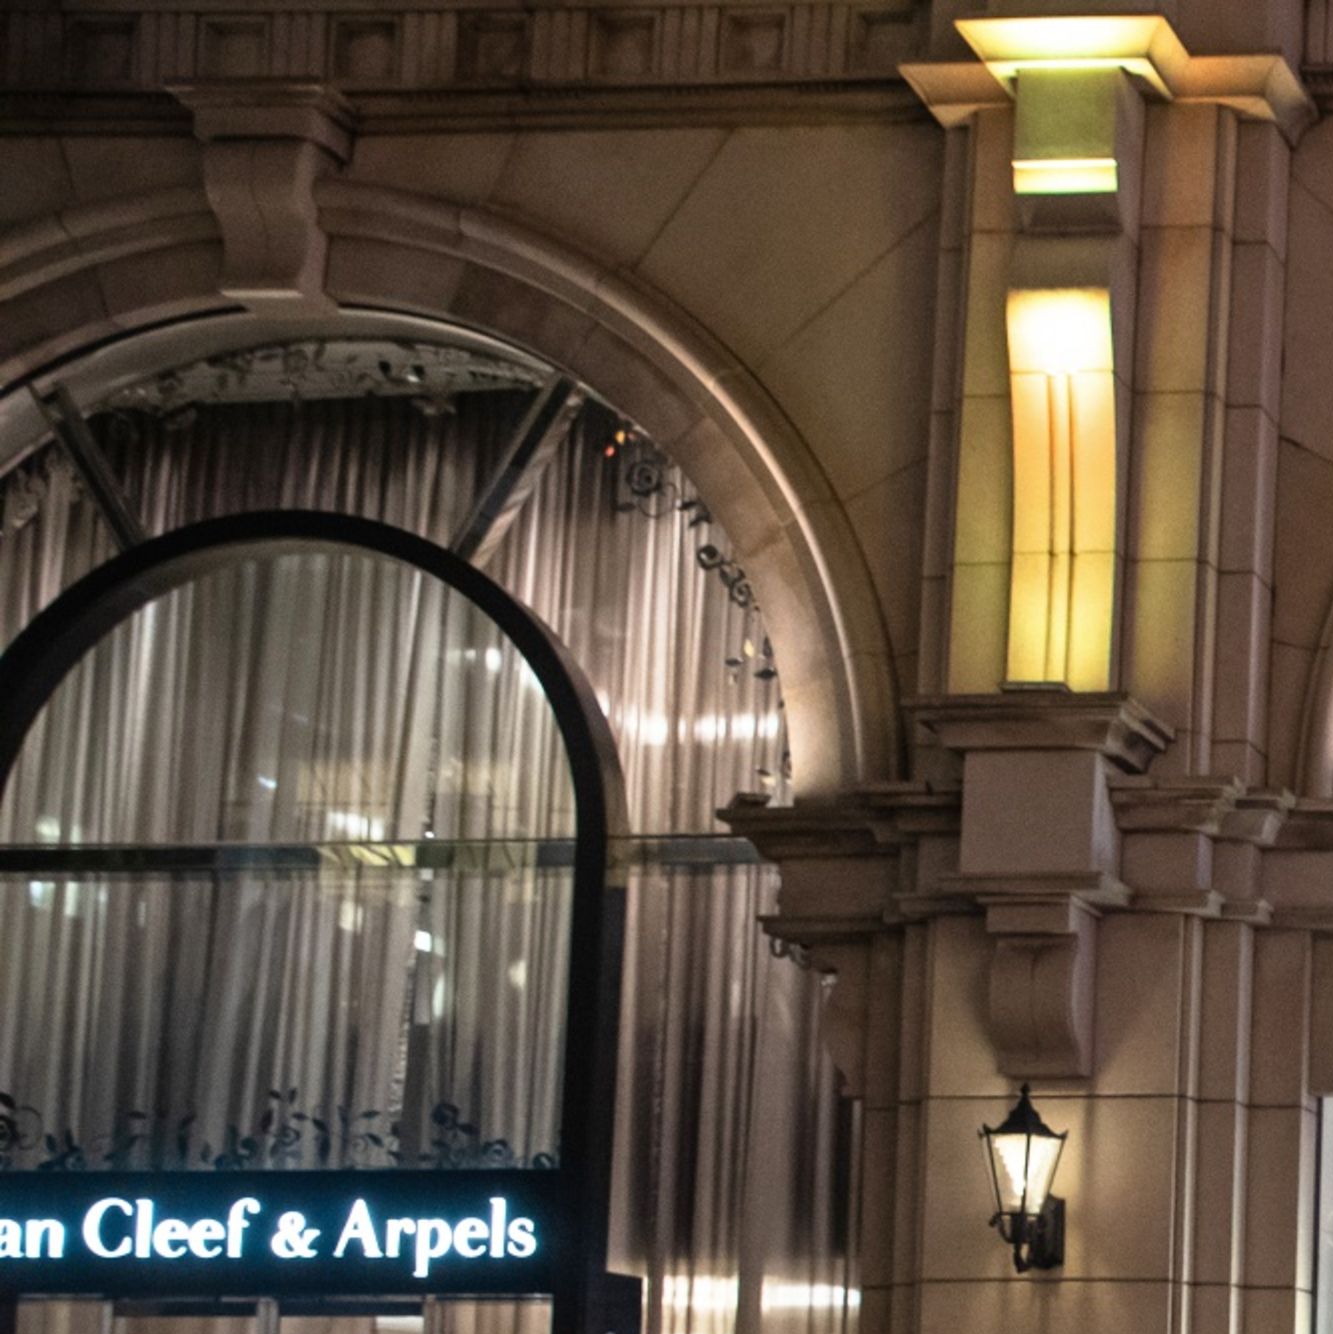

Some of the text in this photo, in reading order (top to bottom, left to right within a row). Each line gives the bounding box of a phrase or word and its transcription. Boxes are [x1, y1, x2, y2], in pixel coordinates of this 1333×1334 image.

[82, 1197, 260, 1259] Cleef
[270, 1211, 320, 1259] &
[334, 1197, 537, 1278] Arpels
